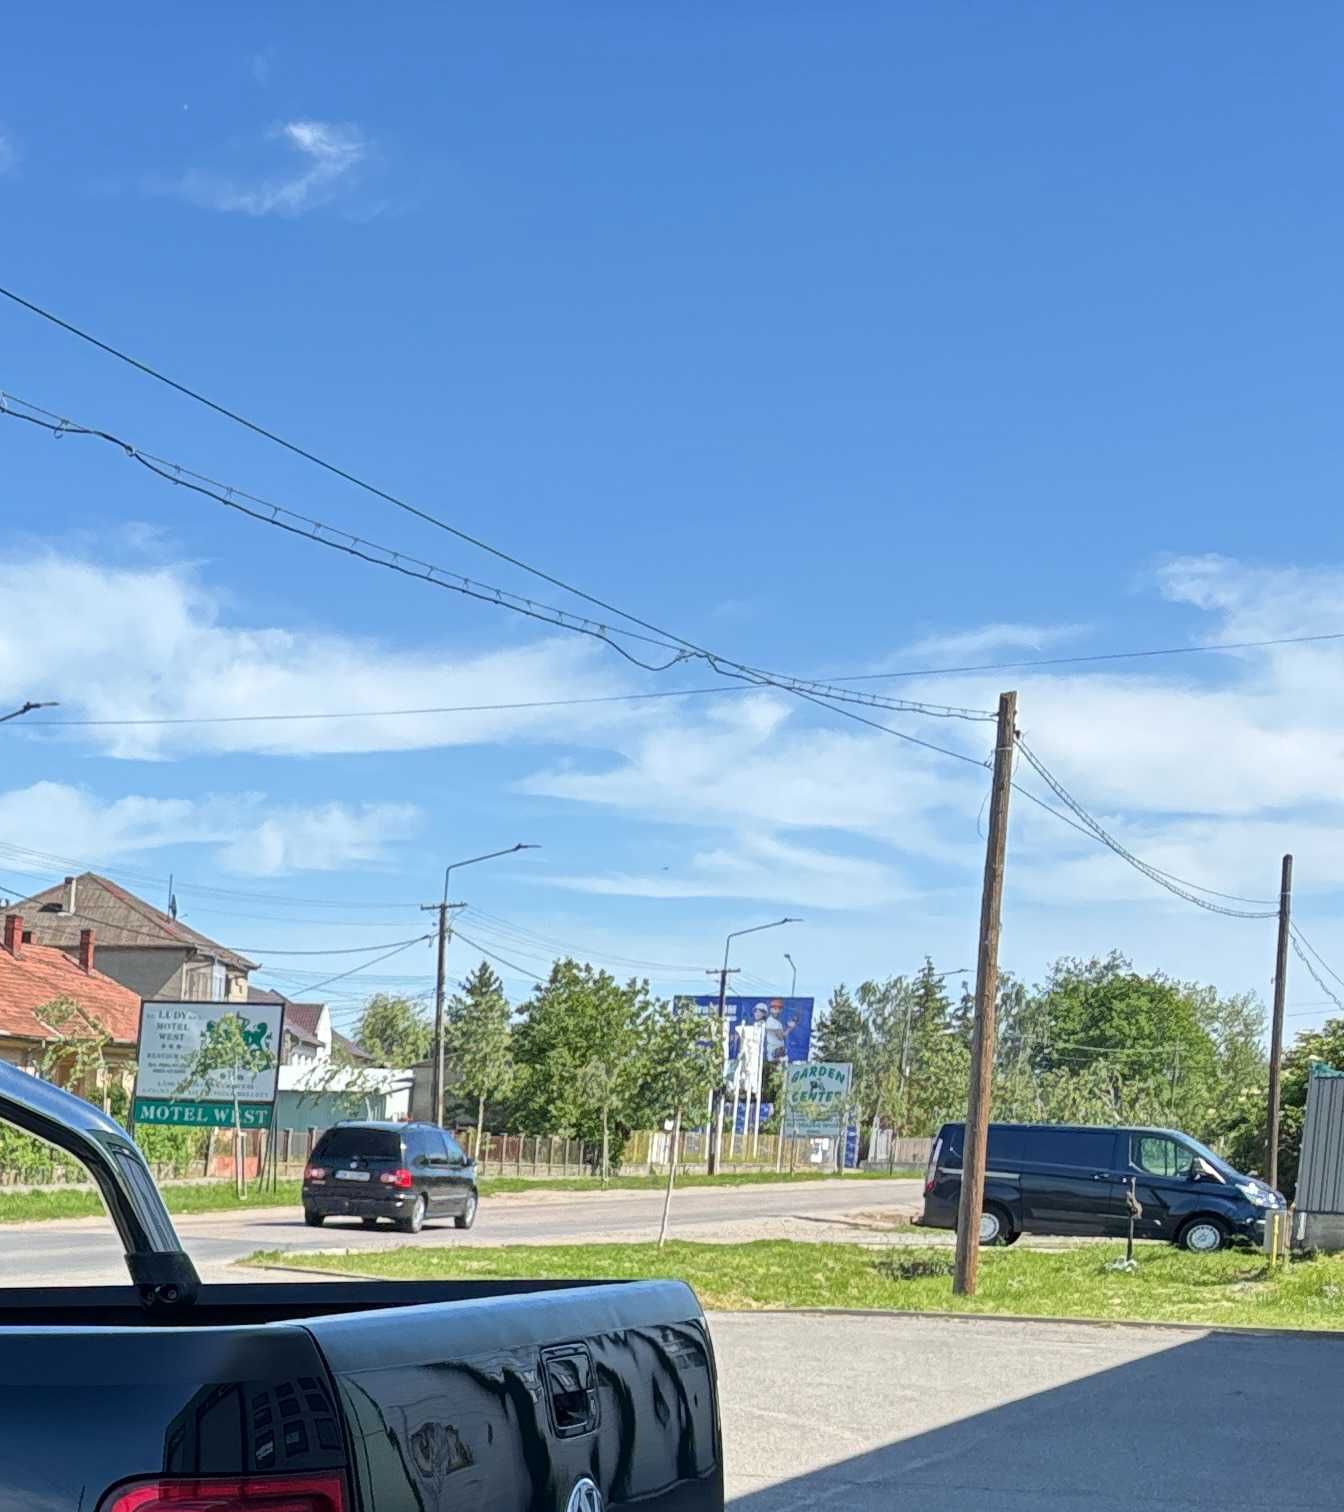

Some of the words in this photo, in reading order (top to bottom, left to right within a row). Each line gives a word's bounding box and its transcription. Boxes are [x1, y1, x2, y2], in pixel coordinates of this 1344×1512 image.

[156, 1022, 190, 1031] MOTEL
[159, 1033, 185, 1041] WEST
[791, 1066, 845, 1084] GARDEN
[140, 1105, 207, 1121] MOTEL
